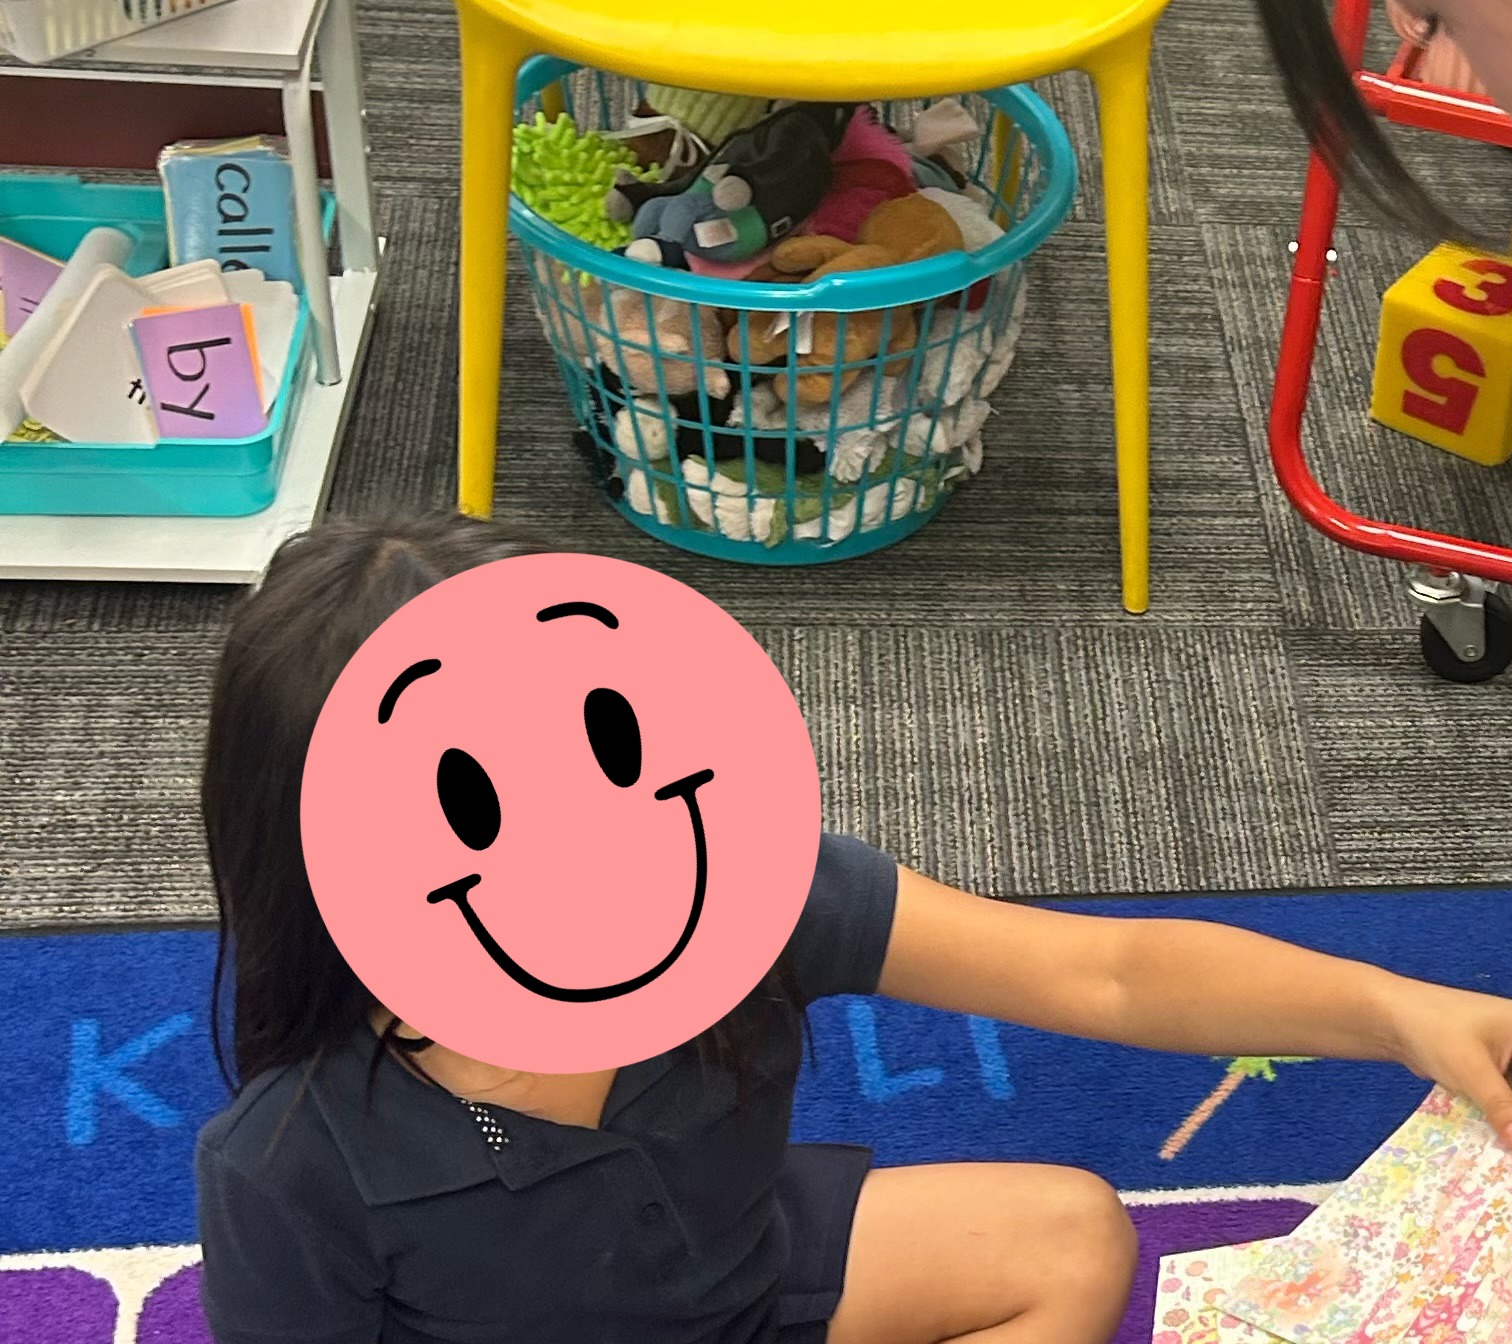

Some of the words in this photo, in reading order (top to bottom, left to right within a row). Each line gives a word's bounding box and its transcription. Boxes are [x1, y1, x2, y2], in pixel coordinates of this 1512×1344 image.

[160, 337, 232, 421] by
[1400, 327, 1487, 436] 5
[66, 1011, 194, 1145] K
